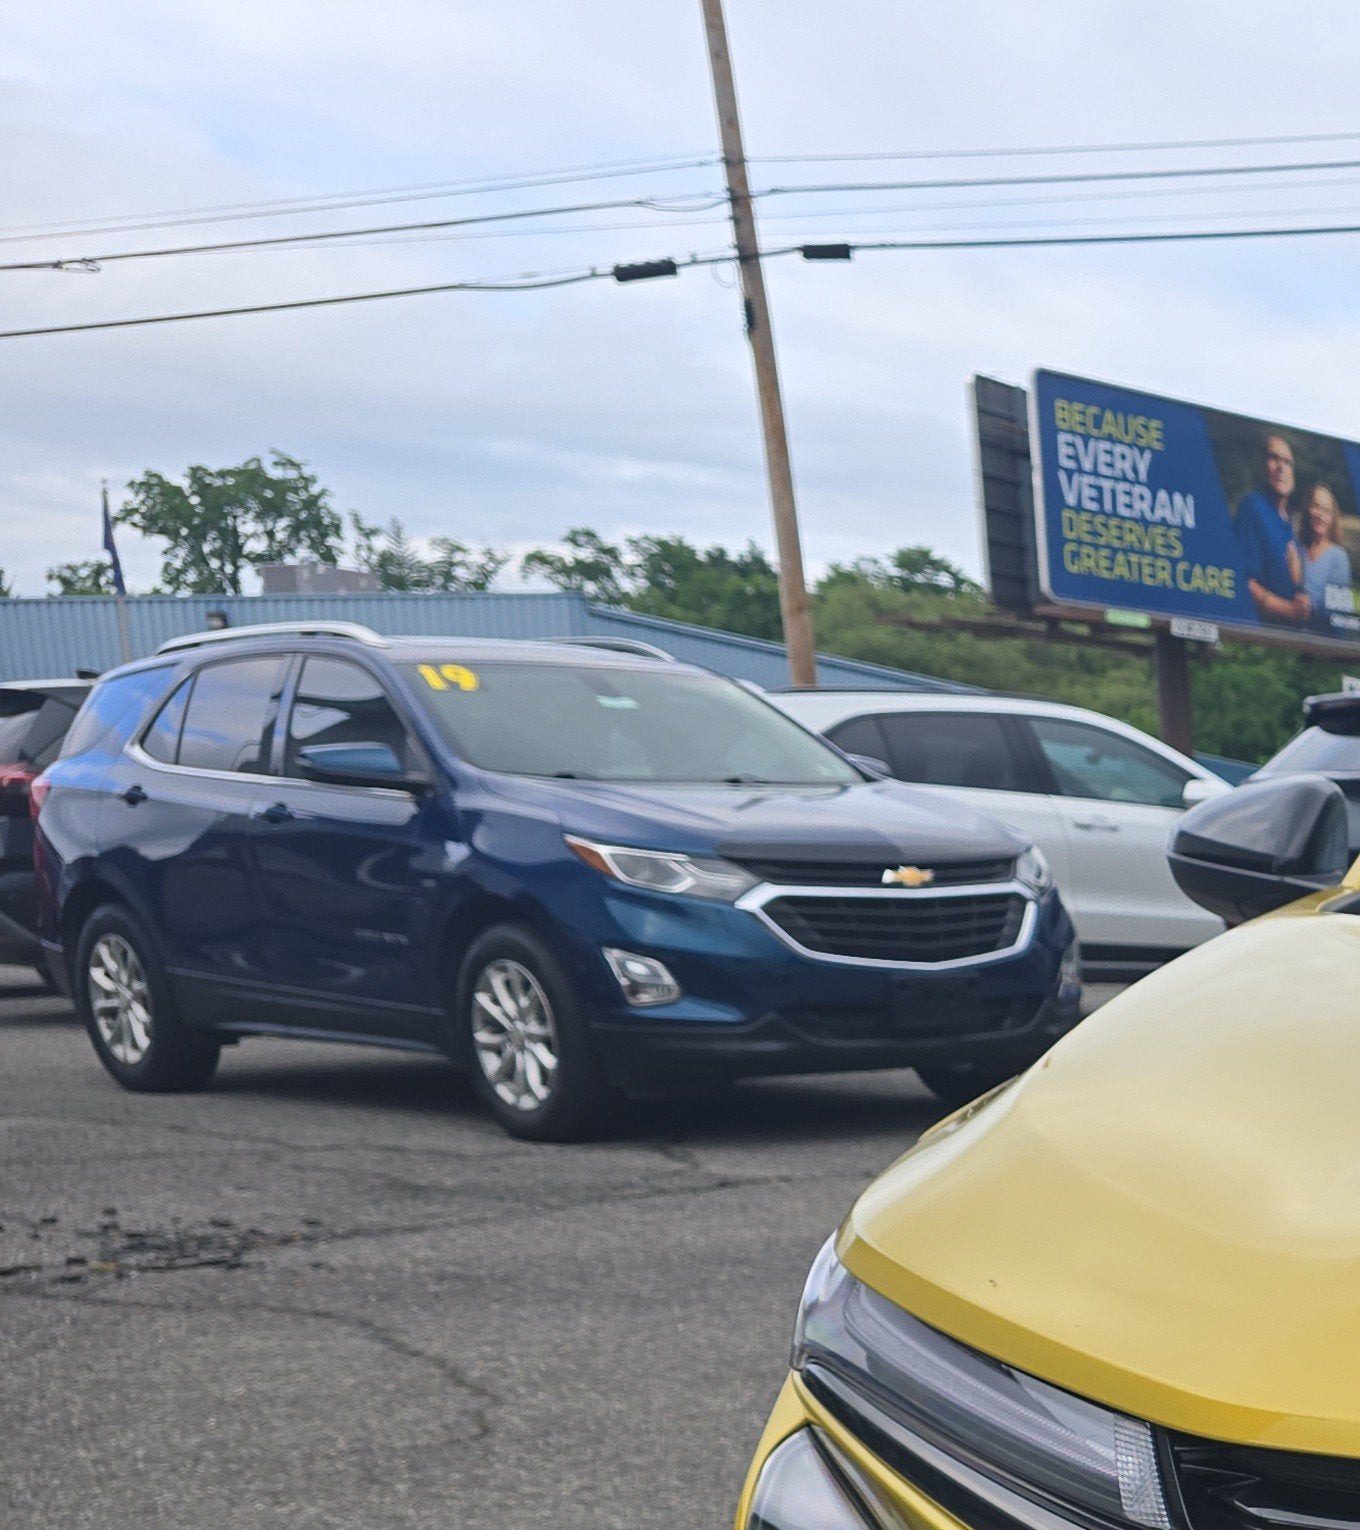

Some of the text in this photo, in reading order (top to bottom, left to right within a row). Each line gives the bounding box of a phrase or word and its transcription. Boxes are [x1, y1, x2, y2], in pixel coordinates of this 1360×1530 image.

[1055, 398, 1165, 451] BECAUSE
[1057, 431, 1153, 483] EVERY
[1057, 469, 1196, 530] VETERAN
[1061, 507, 1184, 558] DESERVES
[1063, 542, 1237, 600] GREATER CARE
[416, 664, 481, 692] 19
